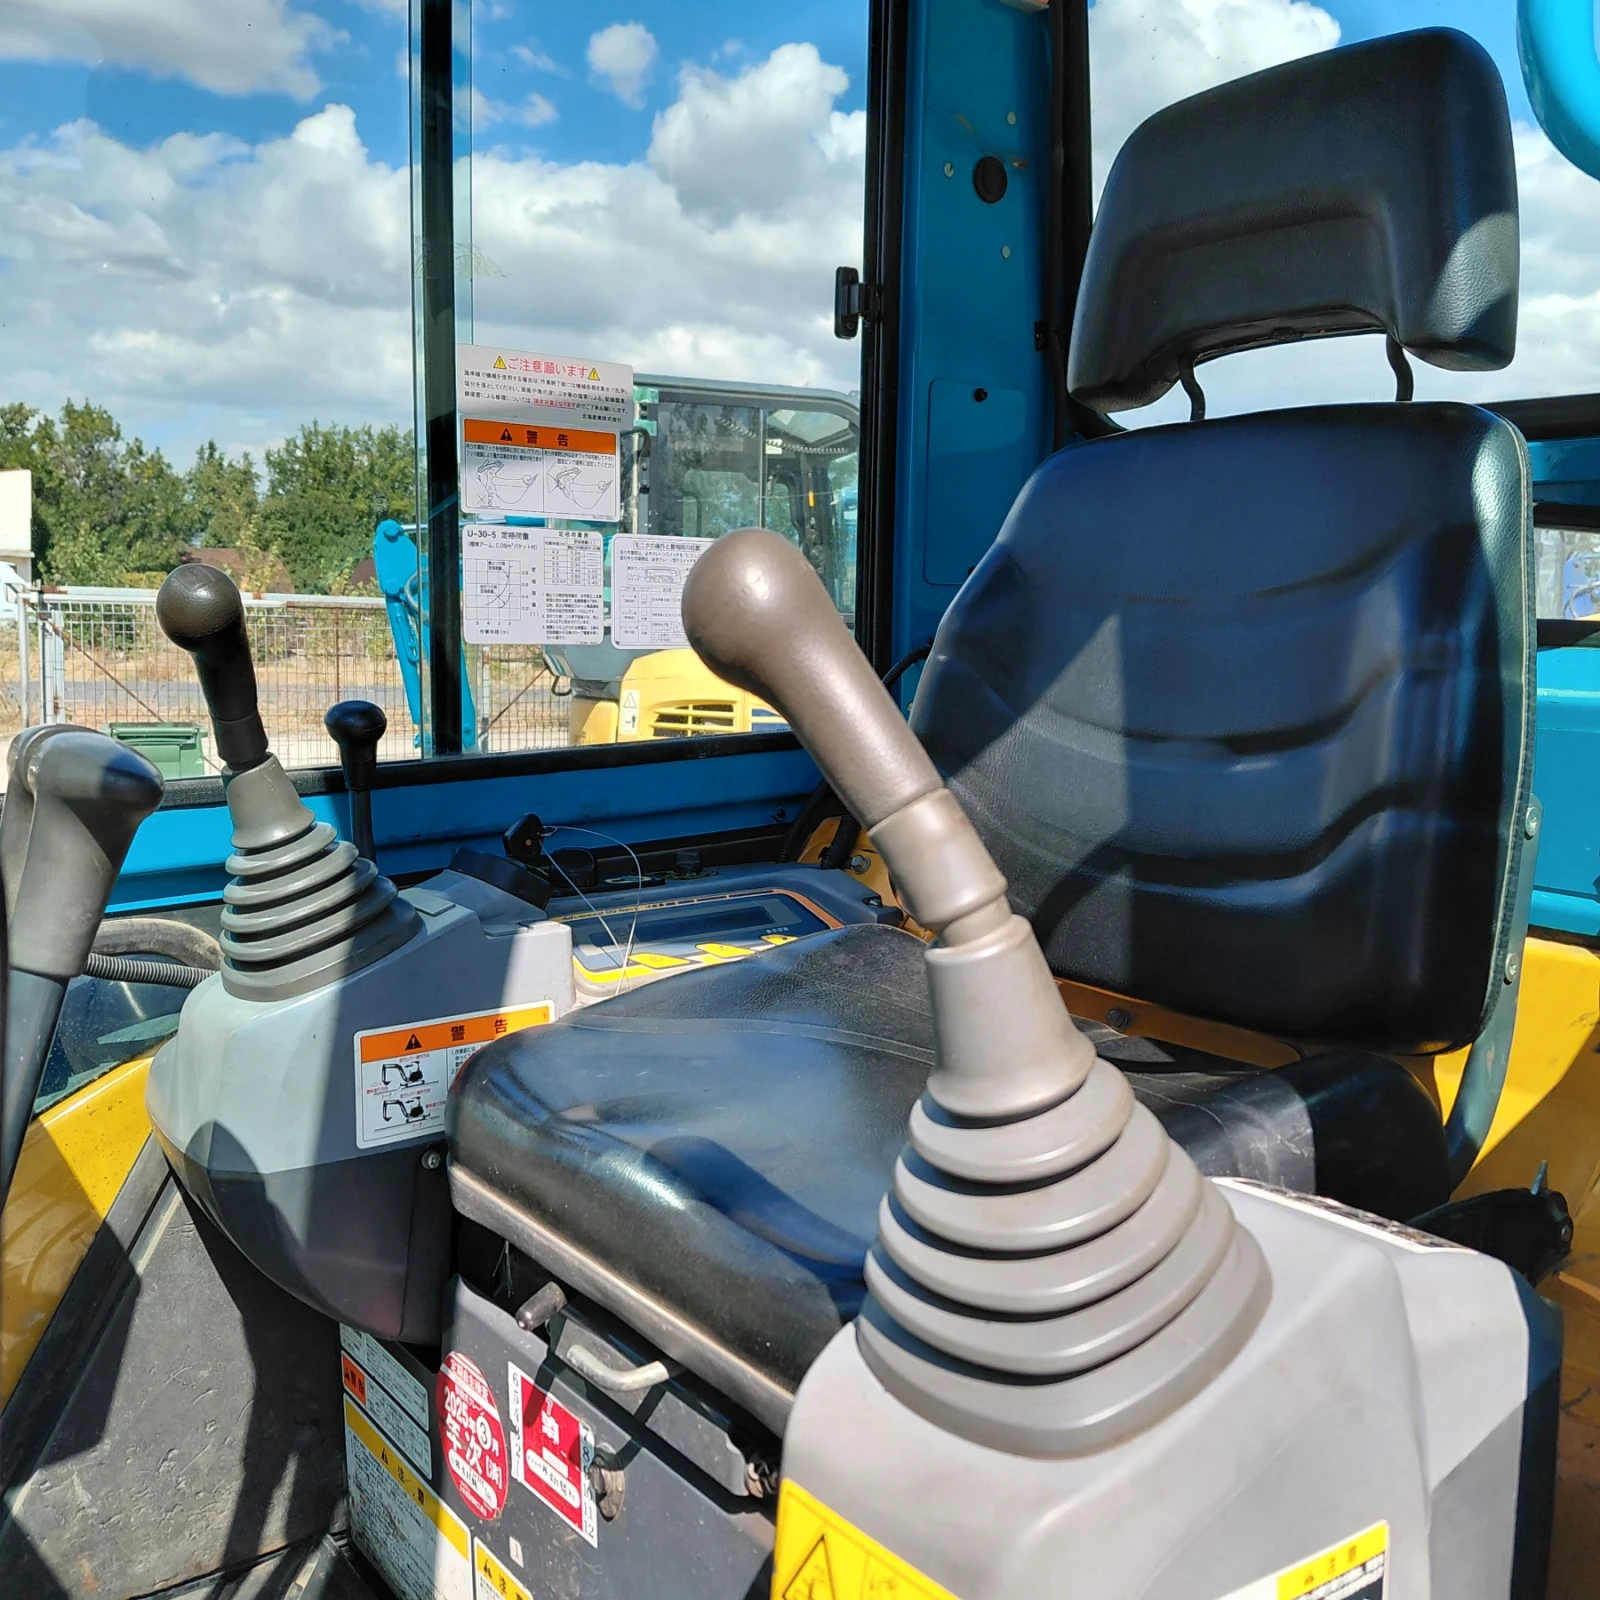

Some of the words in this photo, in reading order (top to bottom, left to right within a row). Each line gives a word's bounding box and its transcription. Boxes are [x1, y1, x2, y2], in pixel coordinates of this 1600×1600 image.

[508, 357, 588, 379] ご注意願います
[467, 530, 497, 538] U-30-5
[501, 531, 529, 540] 定格荷重
[451, 1018, 508, 1042] 警告
[514, 1443, 521, 1459] 2
[582, 1446, 590, 1462] 8
[583, 1502, 593, 1519] 11
[583, 1521, 595, 1539] 12
